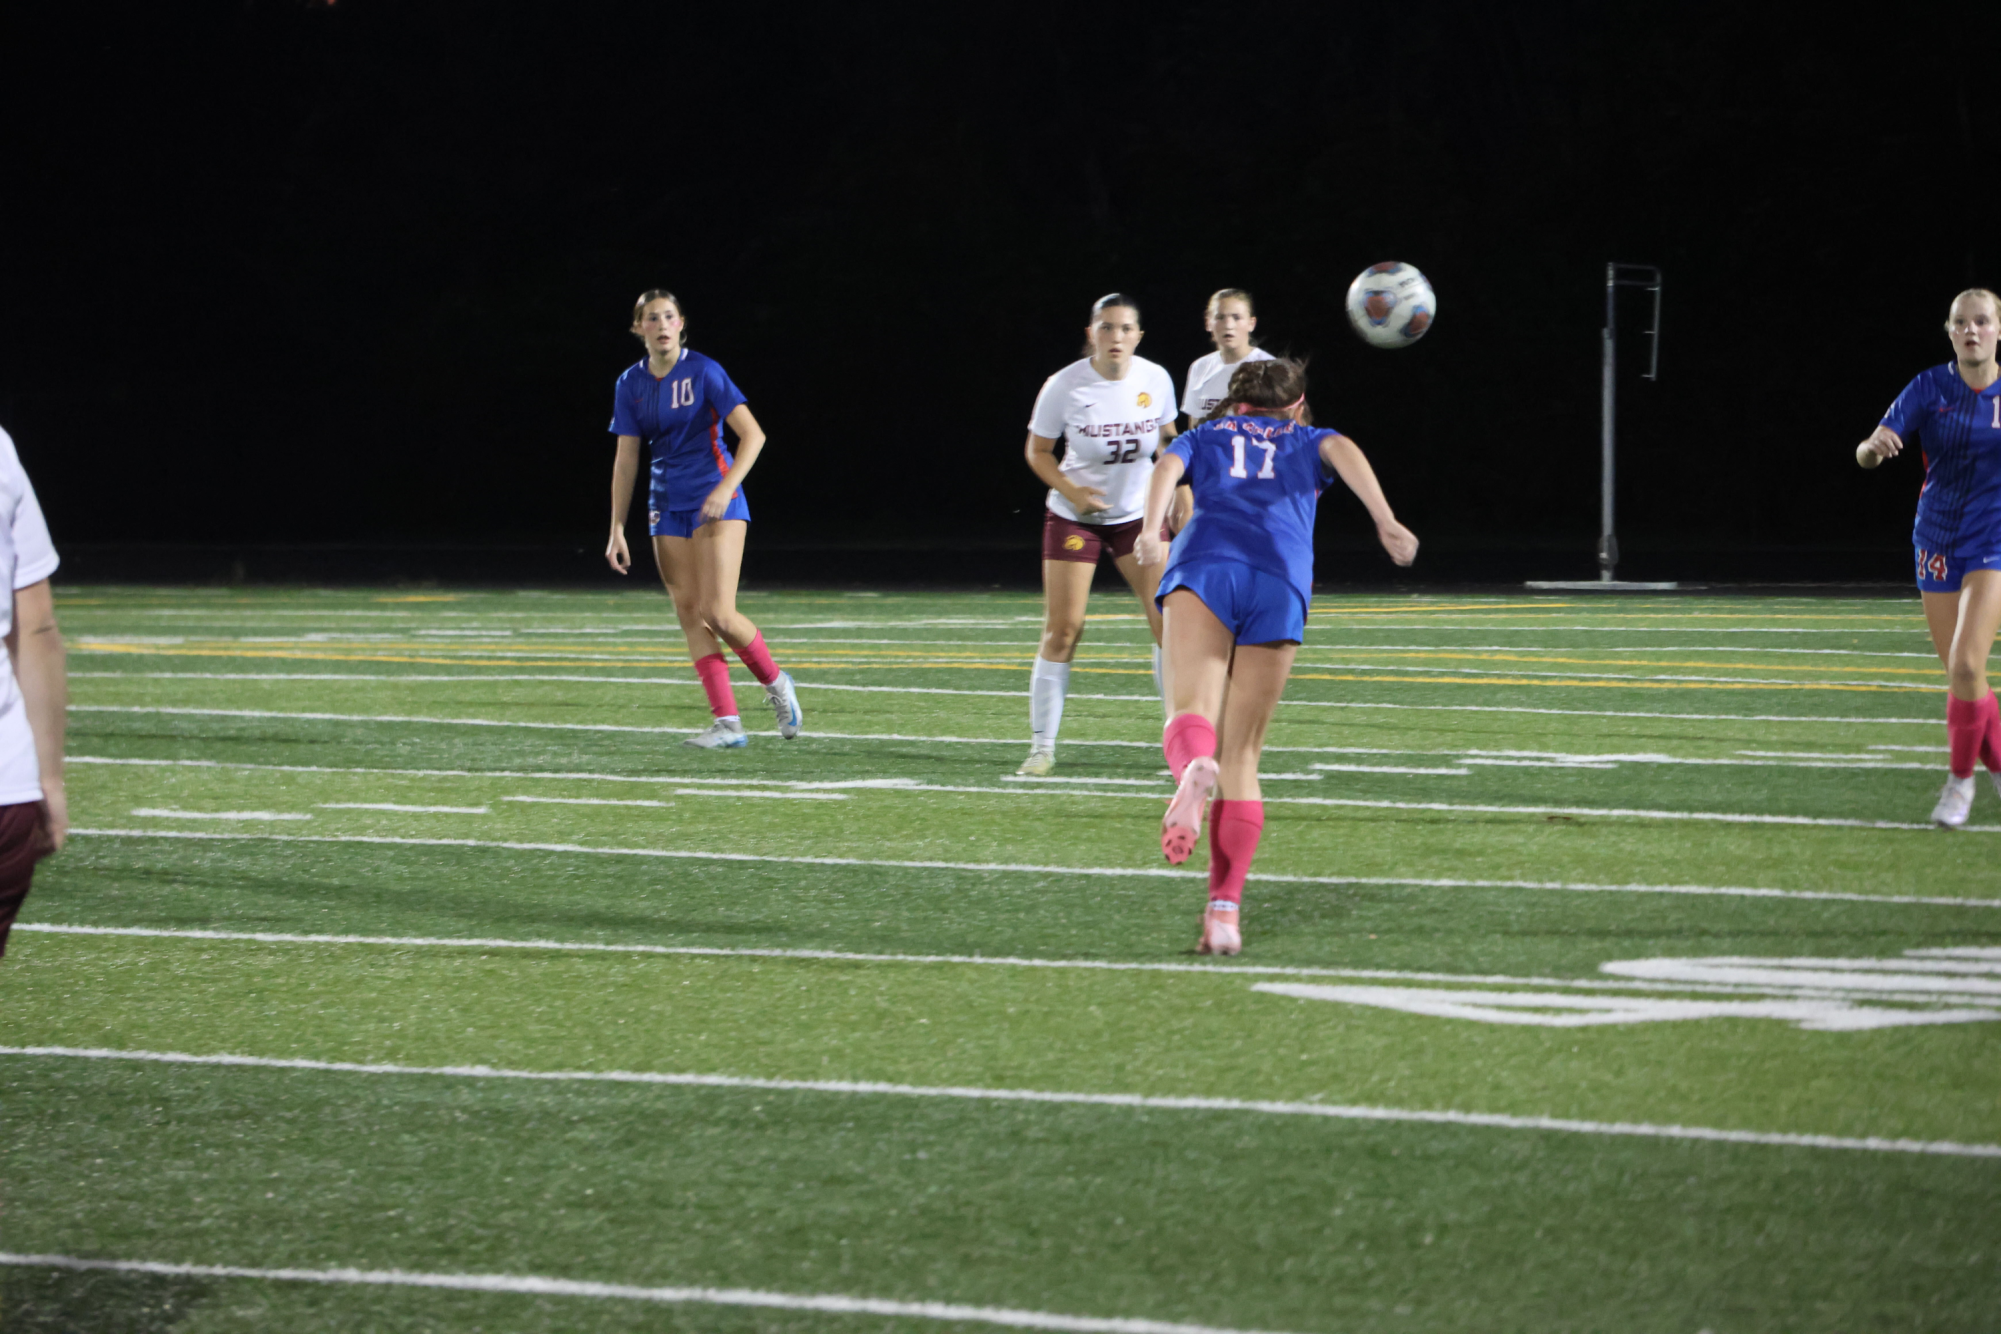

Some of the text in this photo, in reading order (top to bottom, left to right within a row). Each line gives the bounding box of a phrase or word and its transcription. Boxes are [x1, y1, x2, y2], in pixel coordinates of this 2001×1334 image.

[671, 377, 695, 409] 10
[1991, 395, 2001, 429] 1
[1102, 438, 1140, 465] 32
[1229, 435, 1276, 479] 17
[1918, 549, 1948, 582] 14
